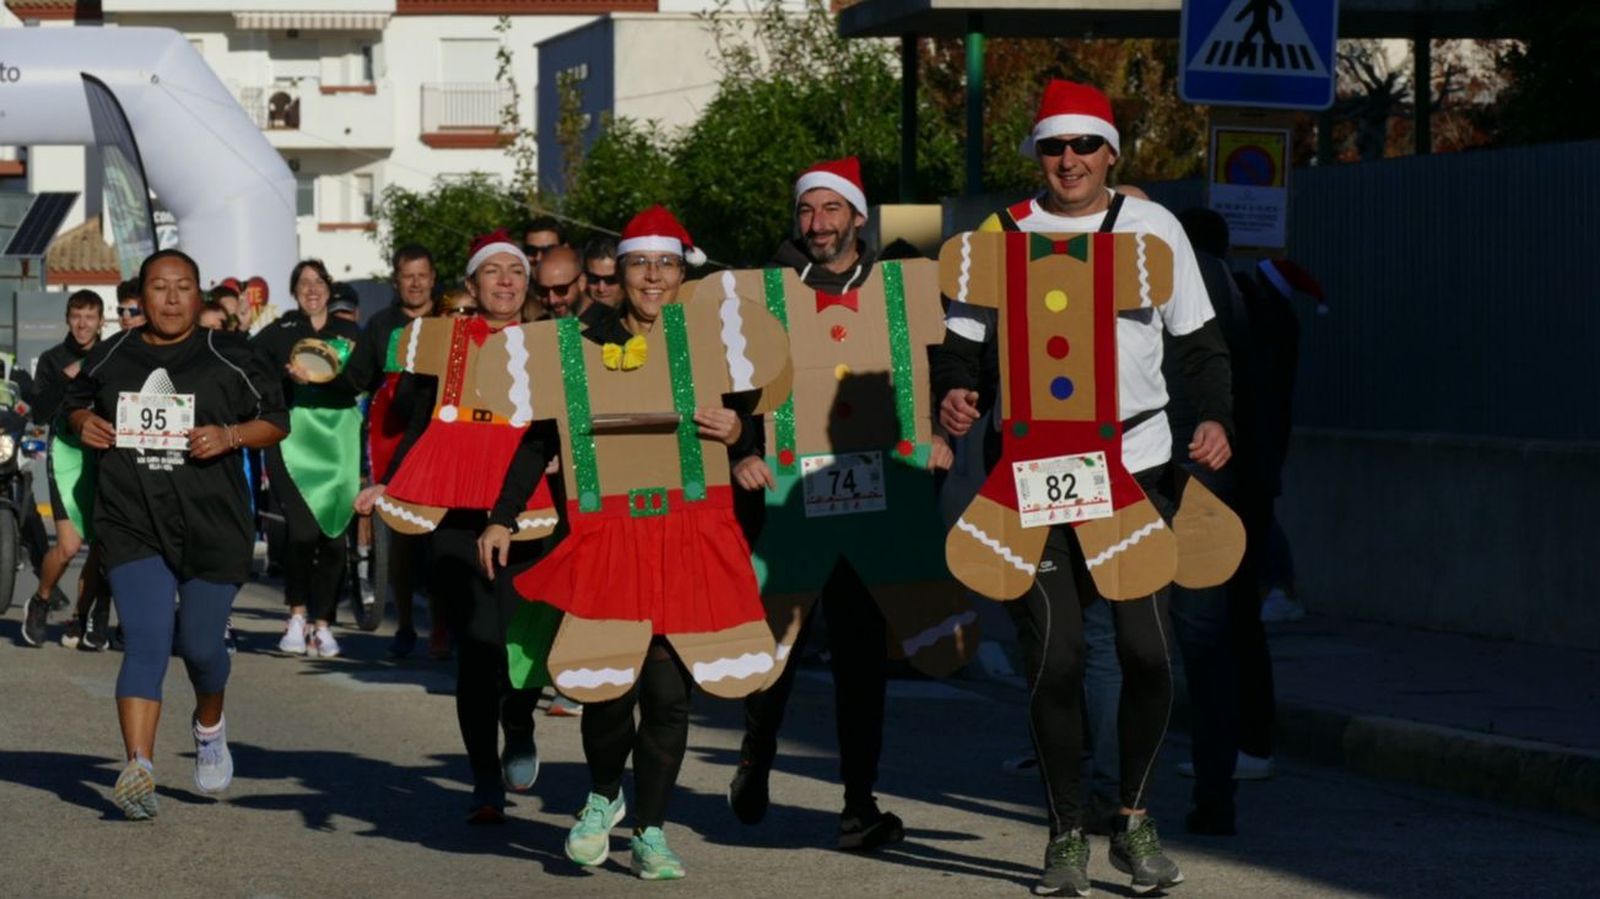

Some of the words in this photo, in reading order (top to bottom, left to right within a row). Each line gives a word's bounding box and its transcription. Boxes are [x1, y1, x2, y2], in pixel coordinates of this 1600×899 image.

[141, 408, 166, 430] 95
[827, 468, 856, 496] 74
[1046, 473, 1078, 502] 82
